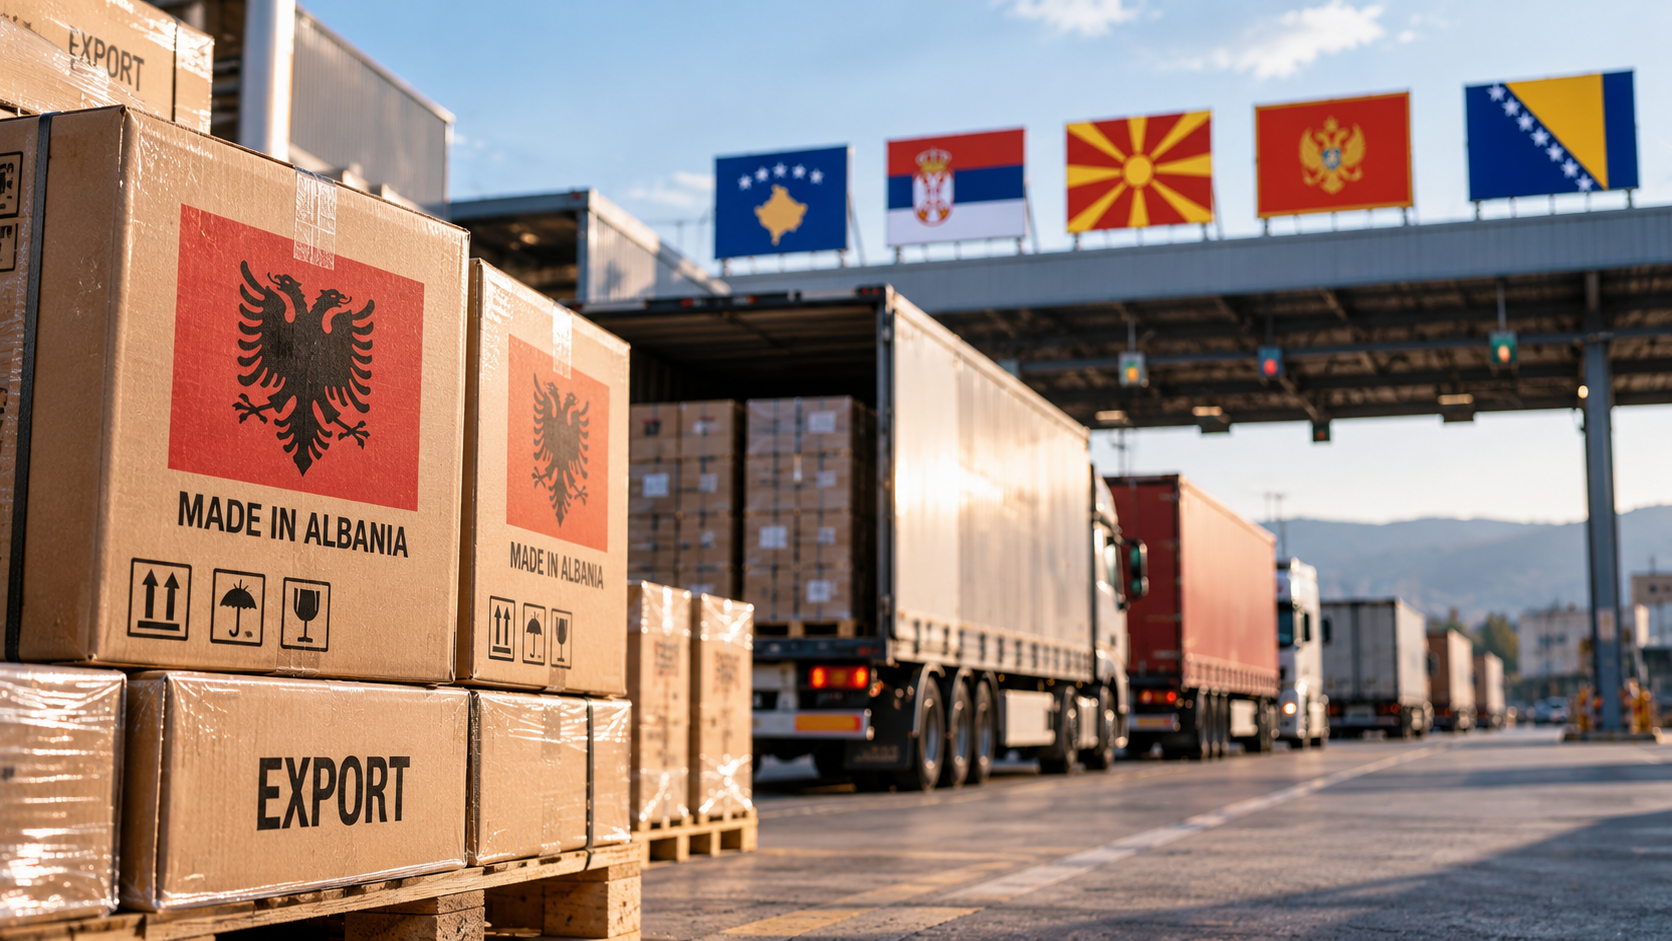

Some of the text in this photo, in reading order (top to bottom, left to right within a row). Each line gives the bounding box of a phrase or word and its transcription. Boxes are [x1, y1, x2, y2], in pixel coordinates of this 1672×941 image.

[69, 25, 145, 92] EXPORT
[178, 491, 409, 558] MADE IN ALBANIA
[510, 541, 604, 590] MADE IN ALBANIA
[257, 755, 411, 831] EXPORT
